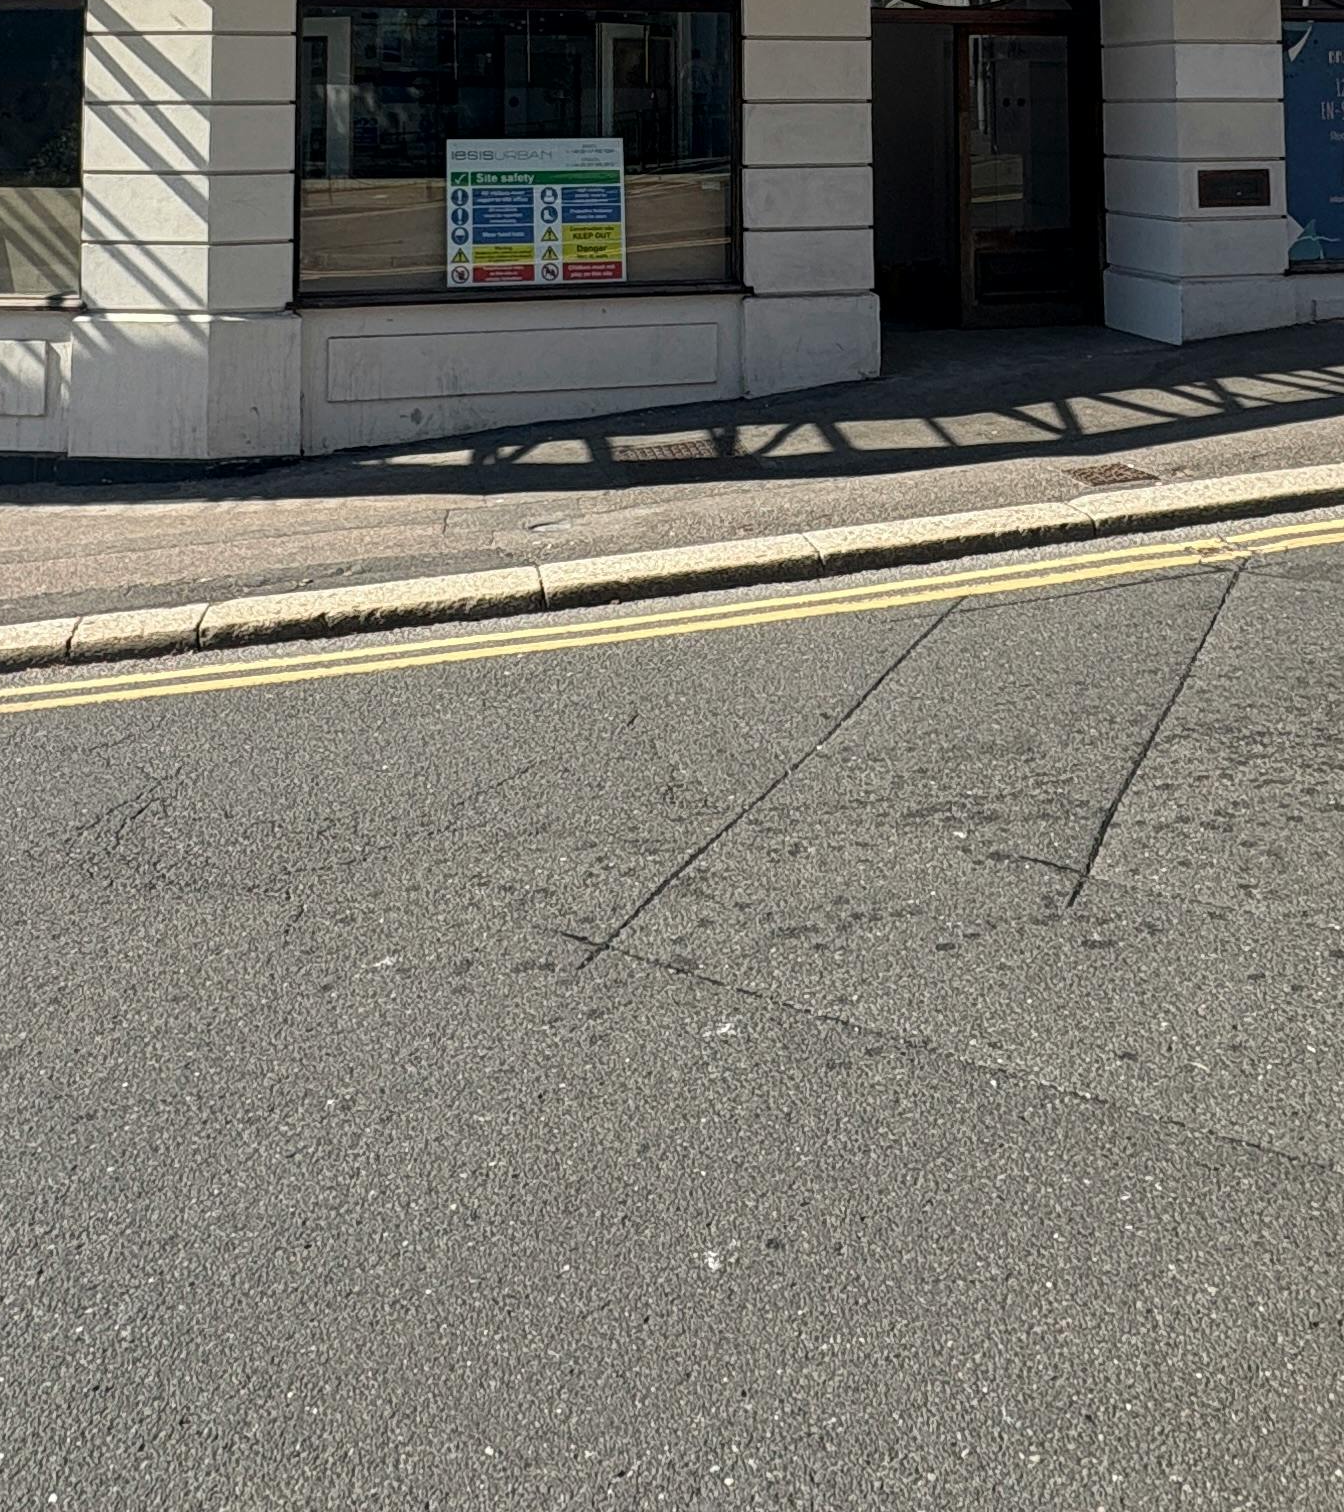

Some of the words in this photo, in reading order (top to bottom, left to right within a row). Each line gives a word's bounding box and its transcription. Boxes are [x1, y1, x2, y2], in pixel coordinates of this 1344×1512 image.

[476, 173, 498, 184] Site
[500, 172, 536, 185] safety
[573, 232, 594, 240] KEEP
[576, 244, 608, 254] Danger
